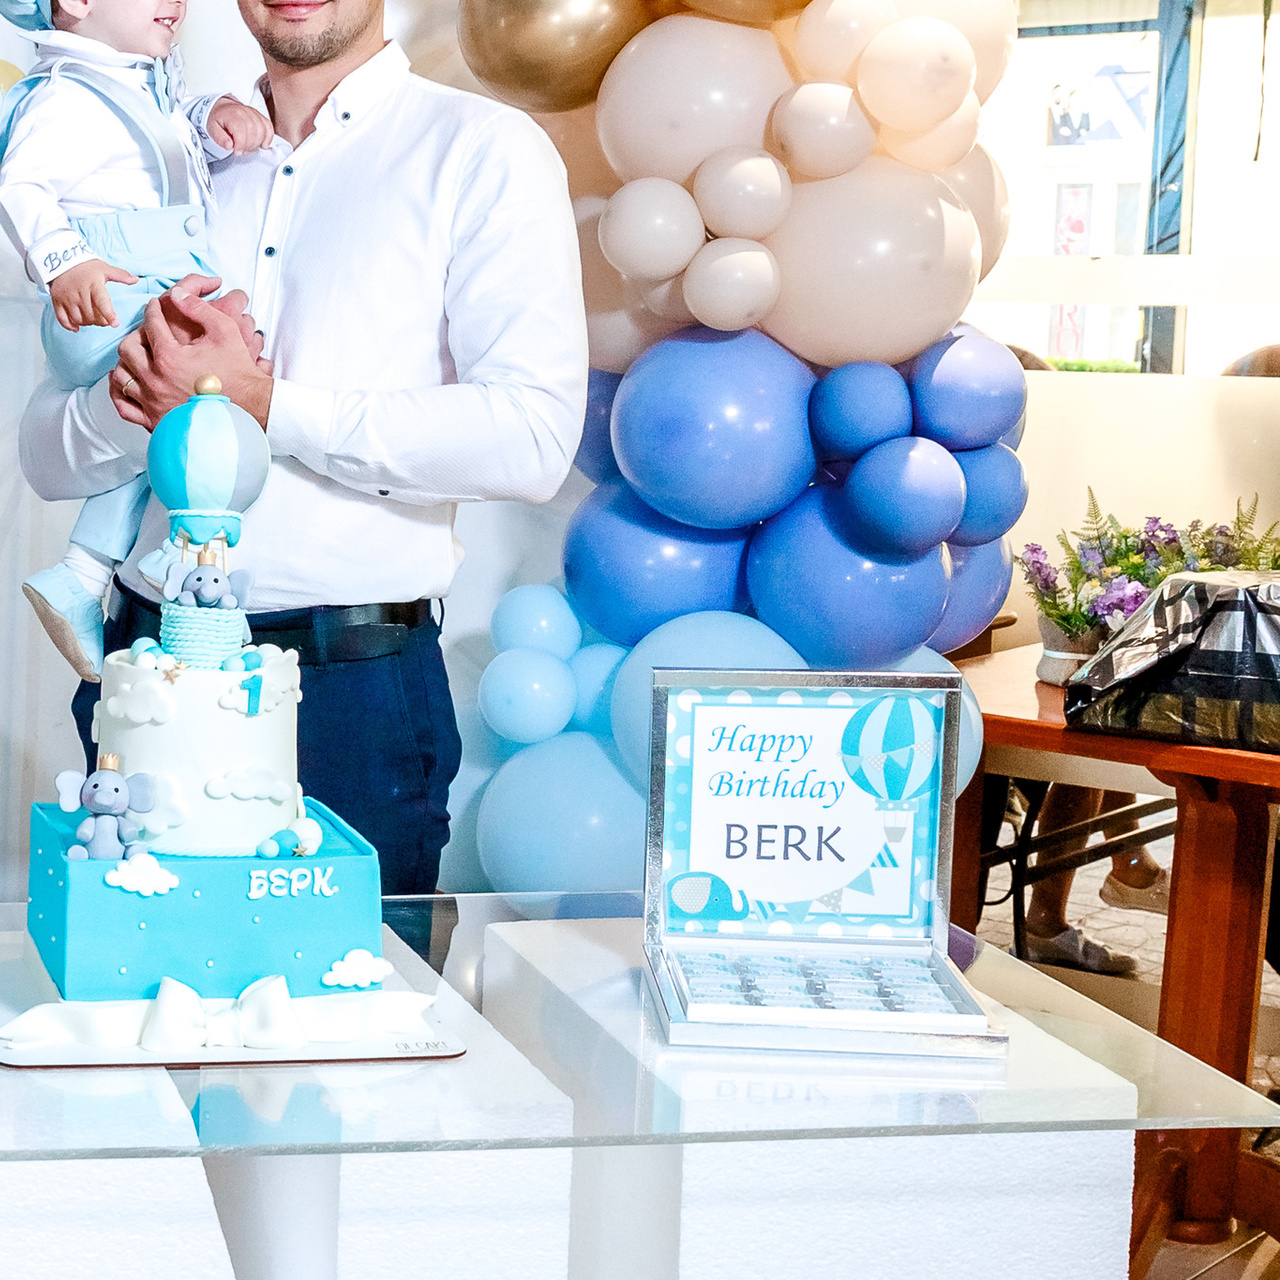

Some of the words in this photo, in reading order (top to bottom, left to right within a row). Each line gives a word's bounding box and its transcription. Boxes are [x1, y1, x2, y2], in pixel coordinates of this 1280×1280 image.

[43, 240, 95, 273] Berk
[241, 674, 263, 716] 1
[707, 724, 813, 763] Happy
[708, 768, 845, 809] Birthday
[725, 823, 846, 862] BERK
[246, 866, 336, 900] БЕРК
